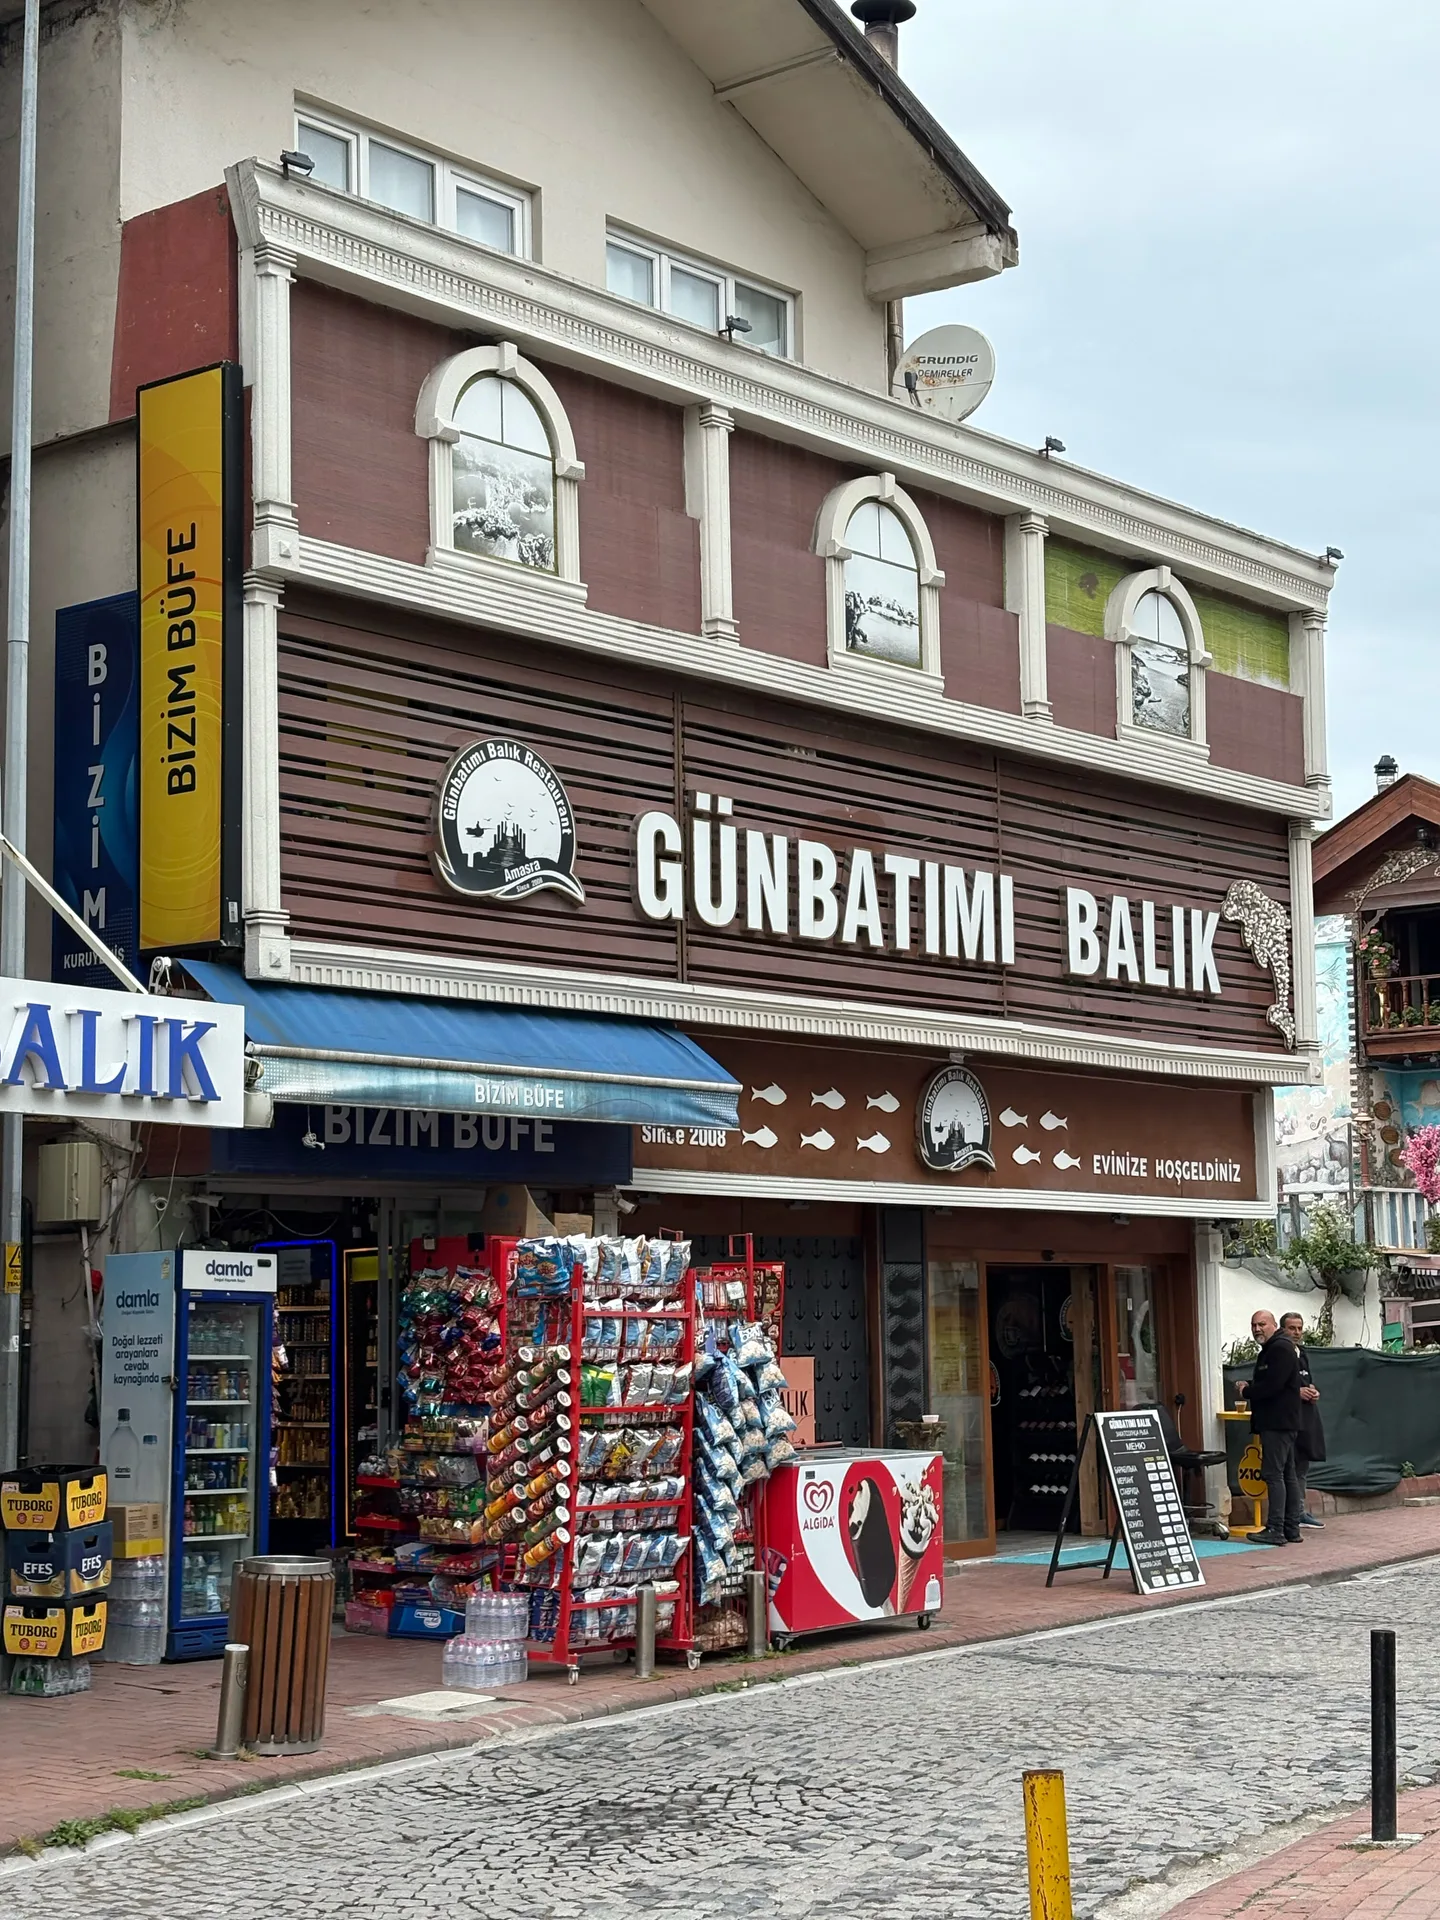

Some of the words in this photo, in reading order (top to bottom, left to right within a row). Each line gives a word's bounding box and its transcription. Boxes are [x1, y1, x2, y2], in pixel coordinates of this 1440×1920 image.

[918, 355, 978, 365] GRUNDIG
[158, 522, 196, 649] BÜFE
[161, 663, 196, 796] BİZİM
[443, 750, 486, 821] Günbatımı
[486, 742, 521, 760] Balık
[524, 750, 572, 835] Restaurant
[504, 860, 541, 883] Amasra
[635, 791, 1016, 967] GÜNBATIMI
[1066, 886, 1222, 995] BALIK
[0, 1003, 221, 1101] ALIK
[475, 1078, 519, 1105] BİZİM
[524, 1083, 564, 1109] BÜFE
[965, 1075, 990, 1126] Restaurant
[953, 1144, 974, 1160] Amasra
[1093, 1150, 1148, 1177] EVİNİZE
[1155, 1157, 1241, 1185] HOŞGELDİNİZ
[205, 1259, 253, 1277] damla
[116, 1289, 160, 1309] damla
[112, 1335, 135, 1349] Doğal
[137, 1333, 163, 1345] lezzeti
[115, 1347, 159, 1360] arayanlara
[124, 1360, 149, 1371] cevabı
[113, 1371, 160, 1386] kaynağında
[1125, 1441, 1147, 1451] МЕНЮ
[7, 1499, 53, 1512] TUBORG
[71, 1491, 102, 1511] TUBORG
[23, 1562, 53, 1575] EFES
[81, 1554, 102, 1573] EFES
[10, 1624, 58, 1638] TUBORG
[75, 1618, 102, 1638] TUBORG
